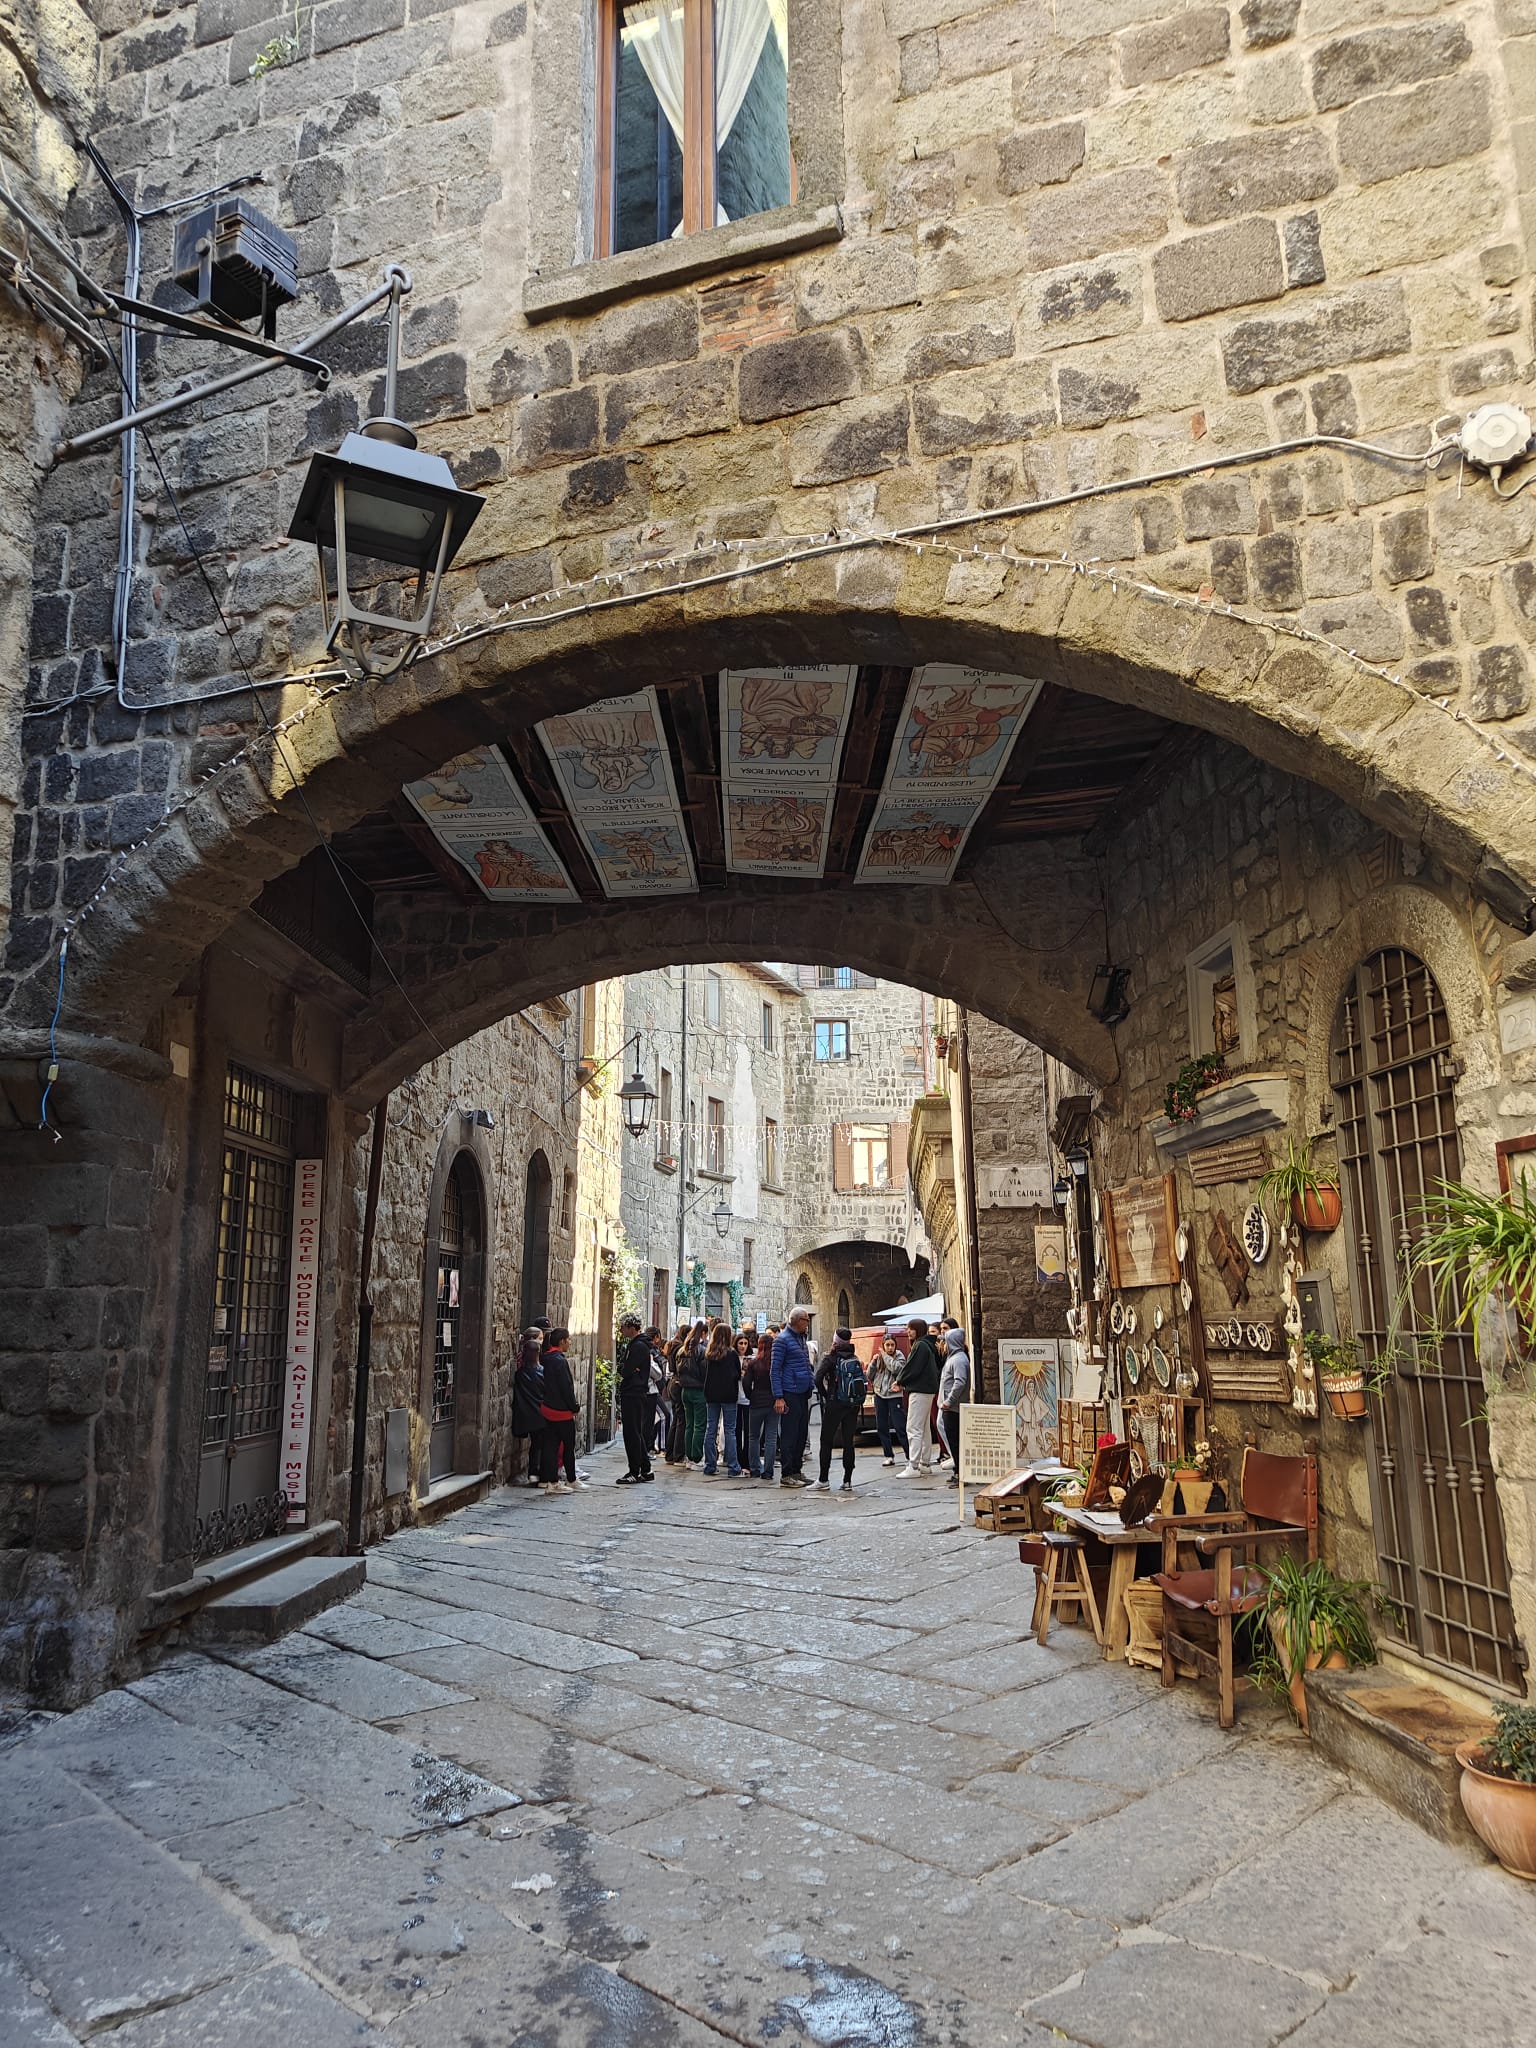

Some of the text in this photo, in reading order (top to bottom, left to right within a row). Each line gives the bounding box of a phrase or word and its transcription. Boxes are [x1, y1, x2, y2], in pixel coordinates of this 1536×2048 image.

[740, 767, 820, 777] LA GIOVANE ROSA
[989, 1190, 1043, 1198] DELLE CAIOLE
[285, 1164, 318, 1518] OPERE D'ARTE MODERNE E ANTICHE E MOSTE
